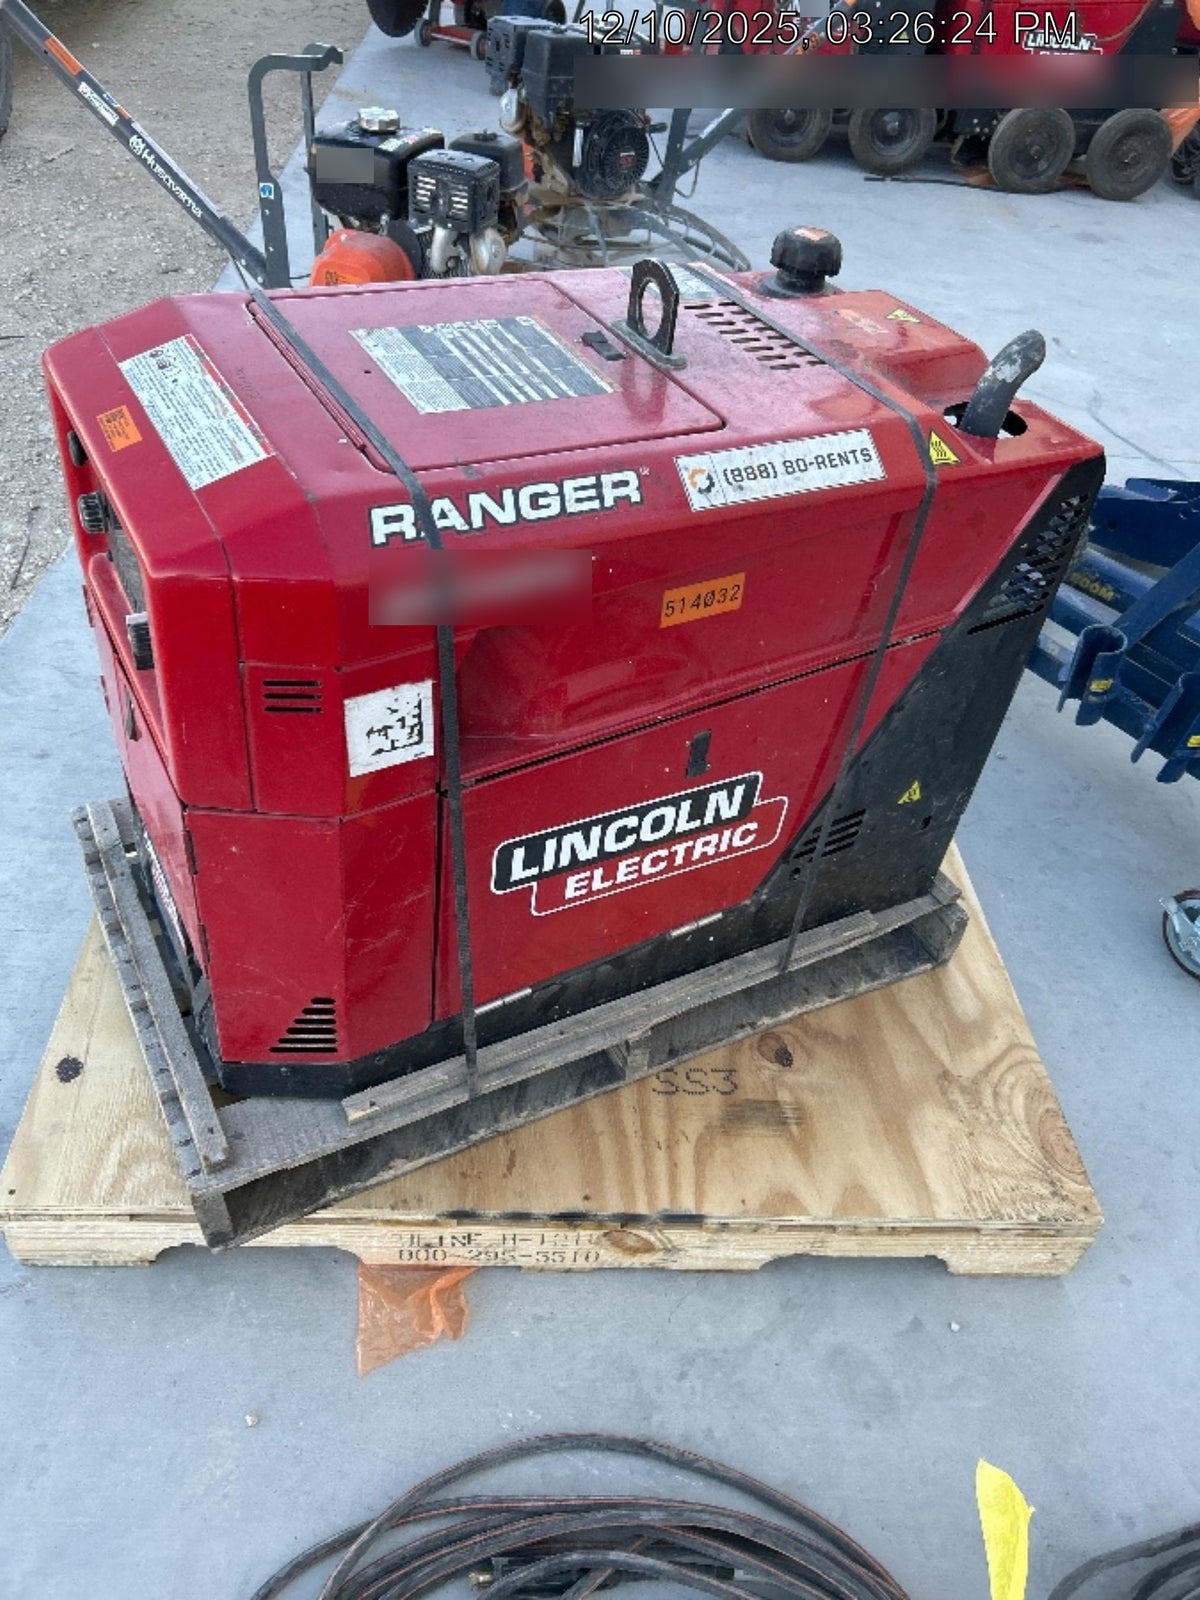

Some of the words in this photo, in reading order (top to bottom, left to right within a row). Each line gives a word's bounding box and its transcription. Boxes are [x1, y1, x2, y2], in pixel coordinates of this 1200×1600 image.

[722, 461, 778, 486] (888)
[782, 446, 873, 476] 80-RENTS
[369, 469, 643, 546] RANGER
[664, 584, 741, 618] 514032
[509, 783, 746, 883] LINCOLN
[564, 821, 760, 901] ELECTRIC
[652, 1067, 739, 1096] SS3
